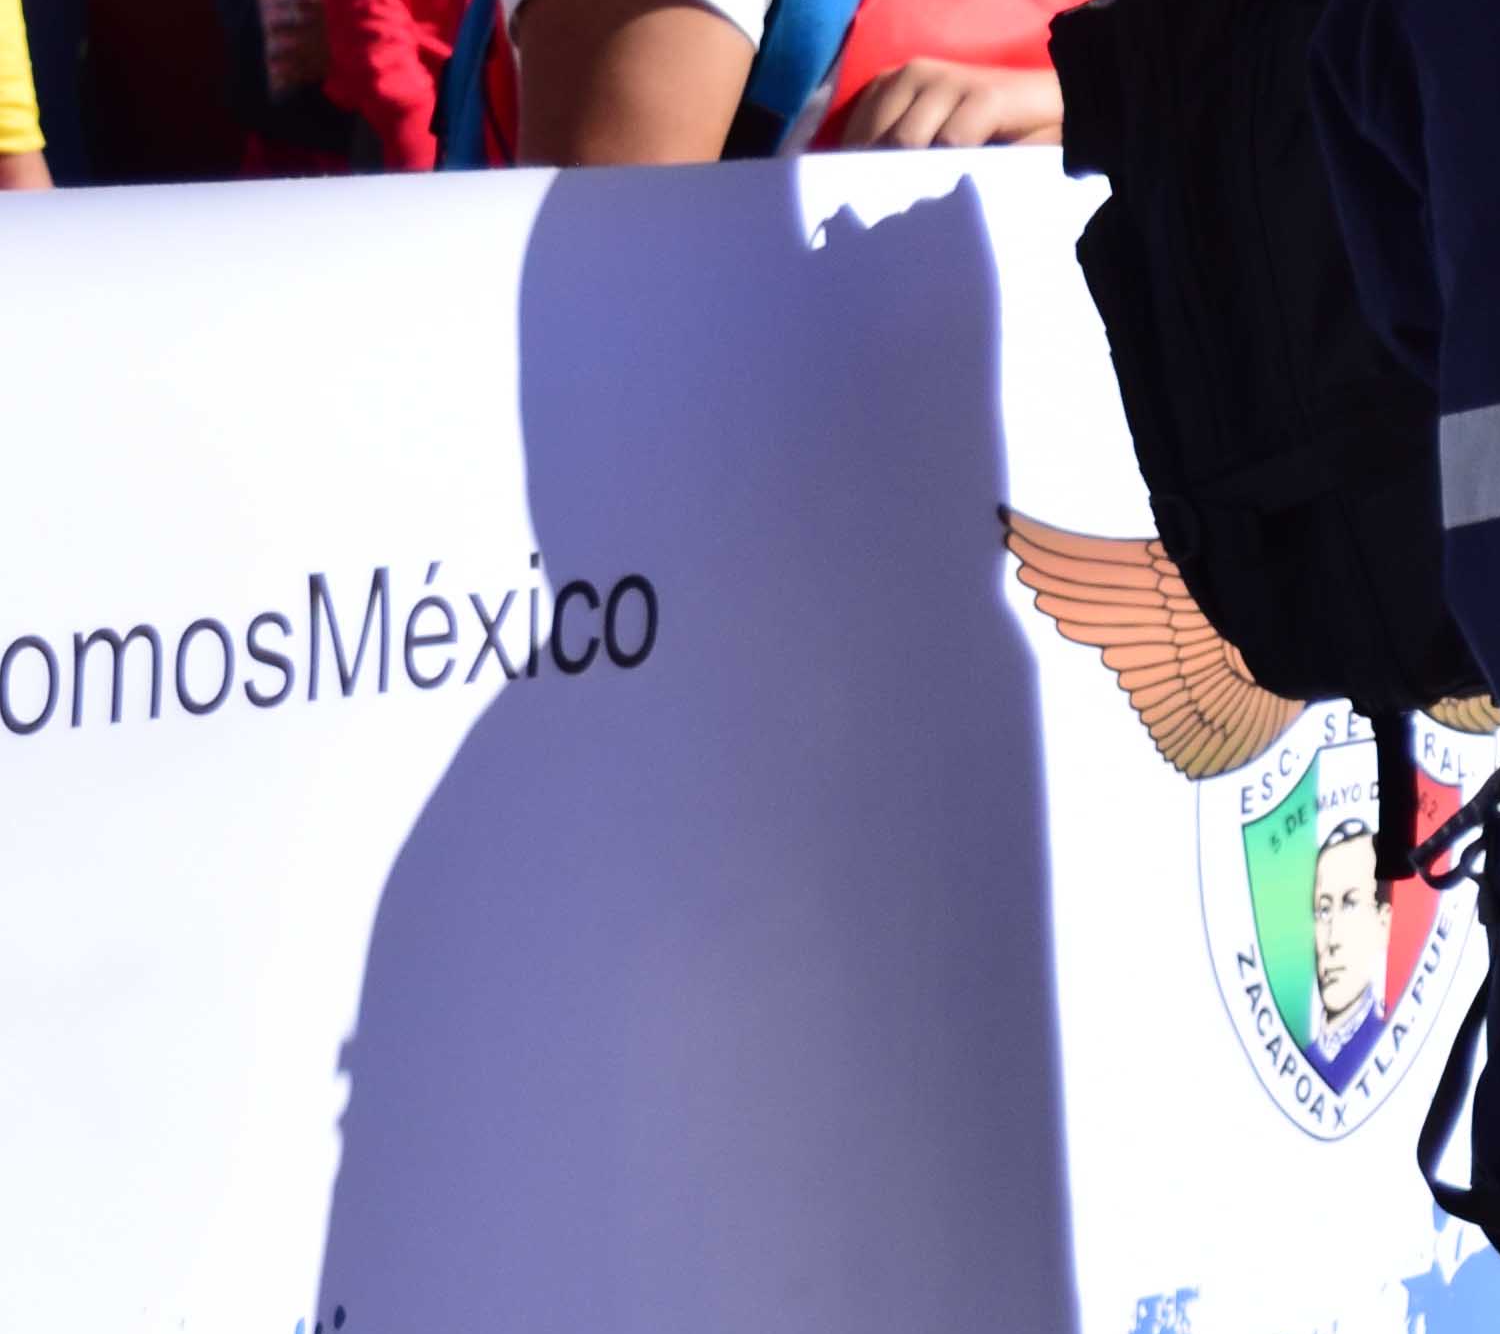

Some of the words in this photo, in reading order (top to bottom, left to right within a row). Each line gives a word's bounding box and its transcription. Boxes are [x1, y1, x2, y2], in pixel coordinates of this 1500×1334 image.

[0, 550, 659, 737] omosMéxico
[1323, 712, 1360, 744] SE
[1283, 804, 1309, 835] DE
[1315, 780, 1362, 813] MAYO
